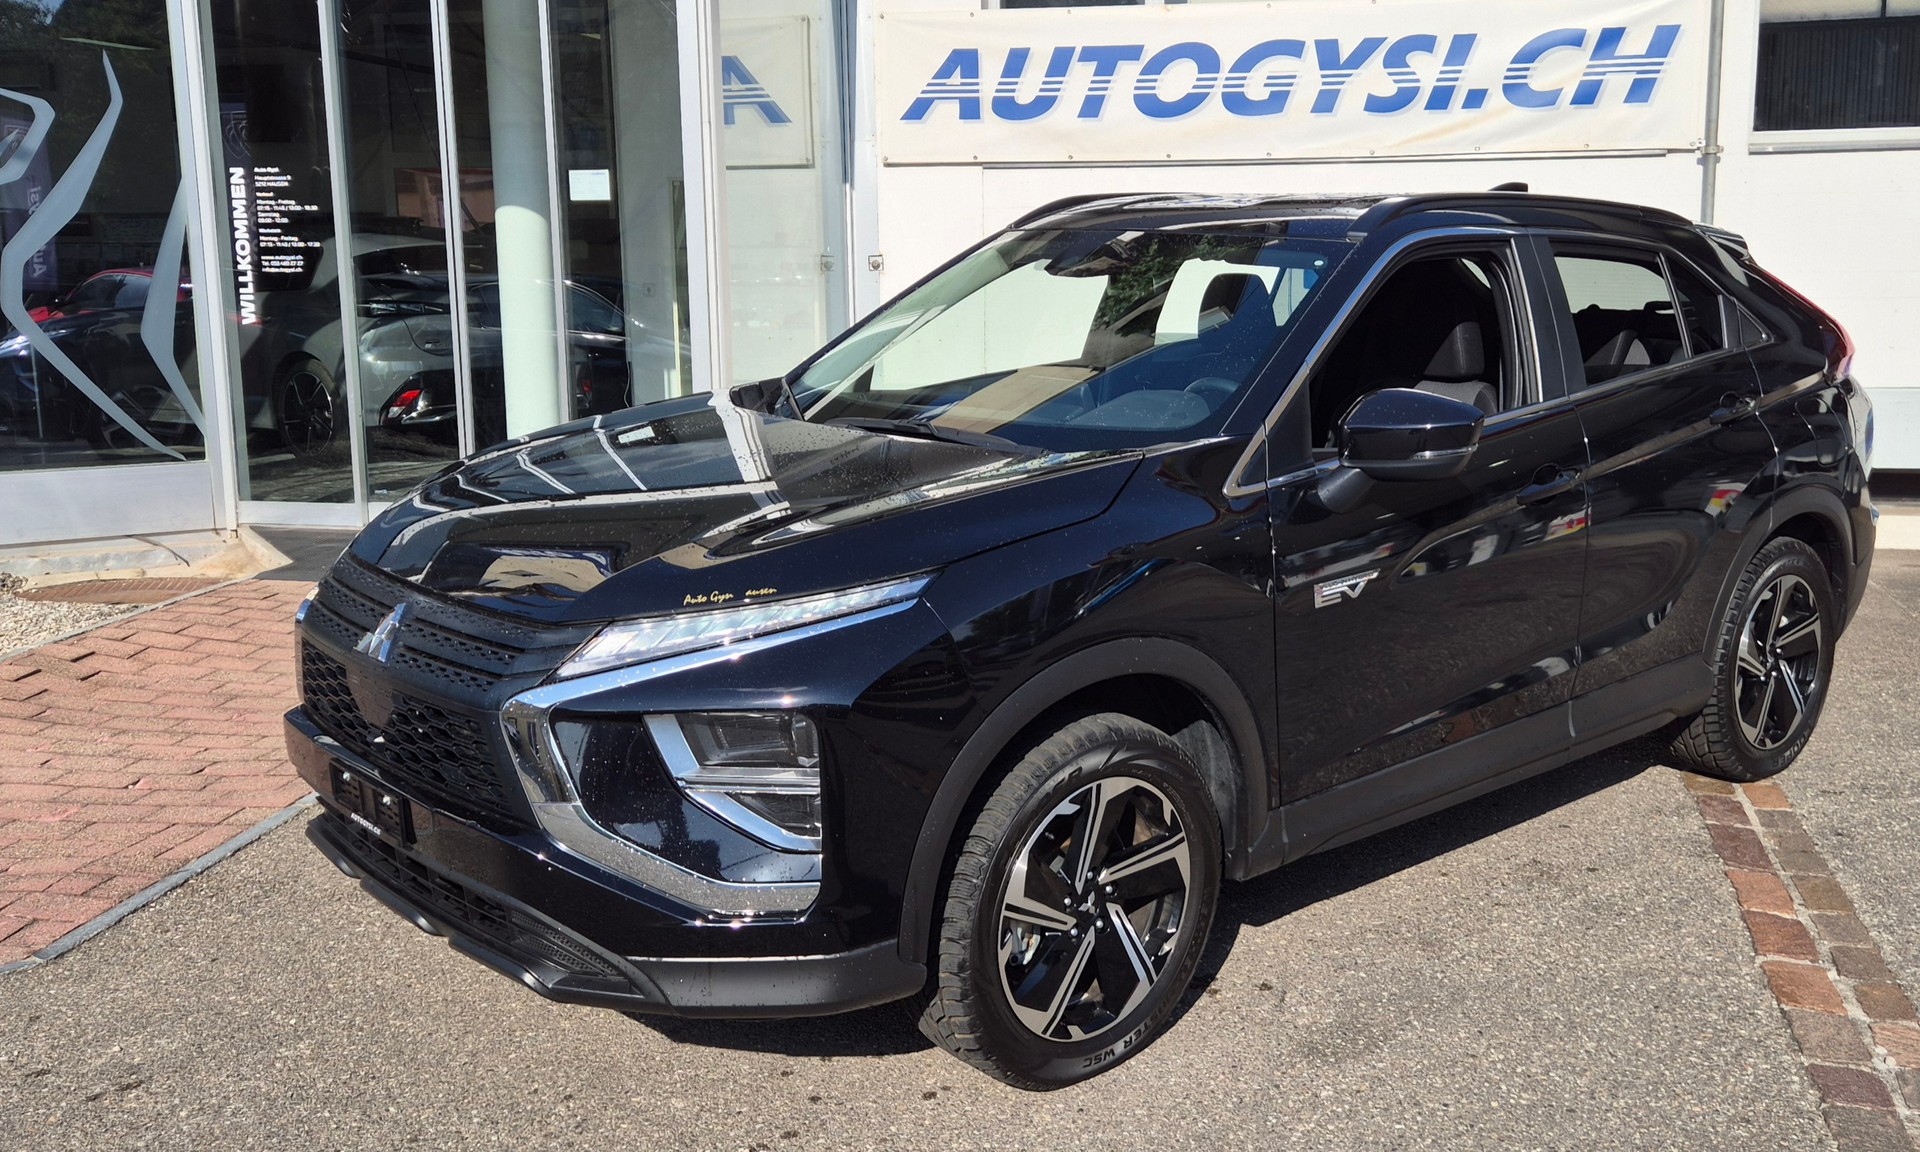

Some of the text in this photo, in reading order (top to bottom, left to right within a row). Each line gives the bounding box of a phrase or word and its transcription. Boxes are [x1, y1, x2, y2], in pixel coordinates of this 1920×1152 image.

[900, 24, 1682, 121] AUTOGYSI.CH
[229, 167, 257, 325] WILLKOMMEN
[683, 594, 707, 606] Auto
[1314, 580, 1368, 609] EV
[1083, 1048, 1116, 1069] WSC
